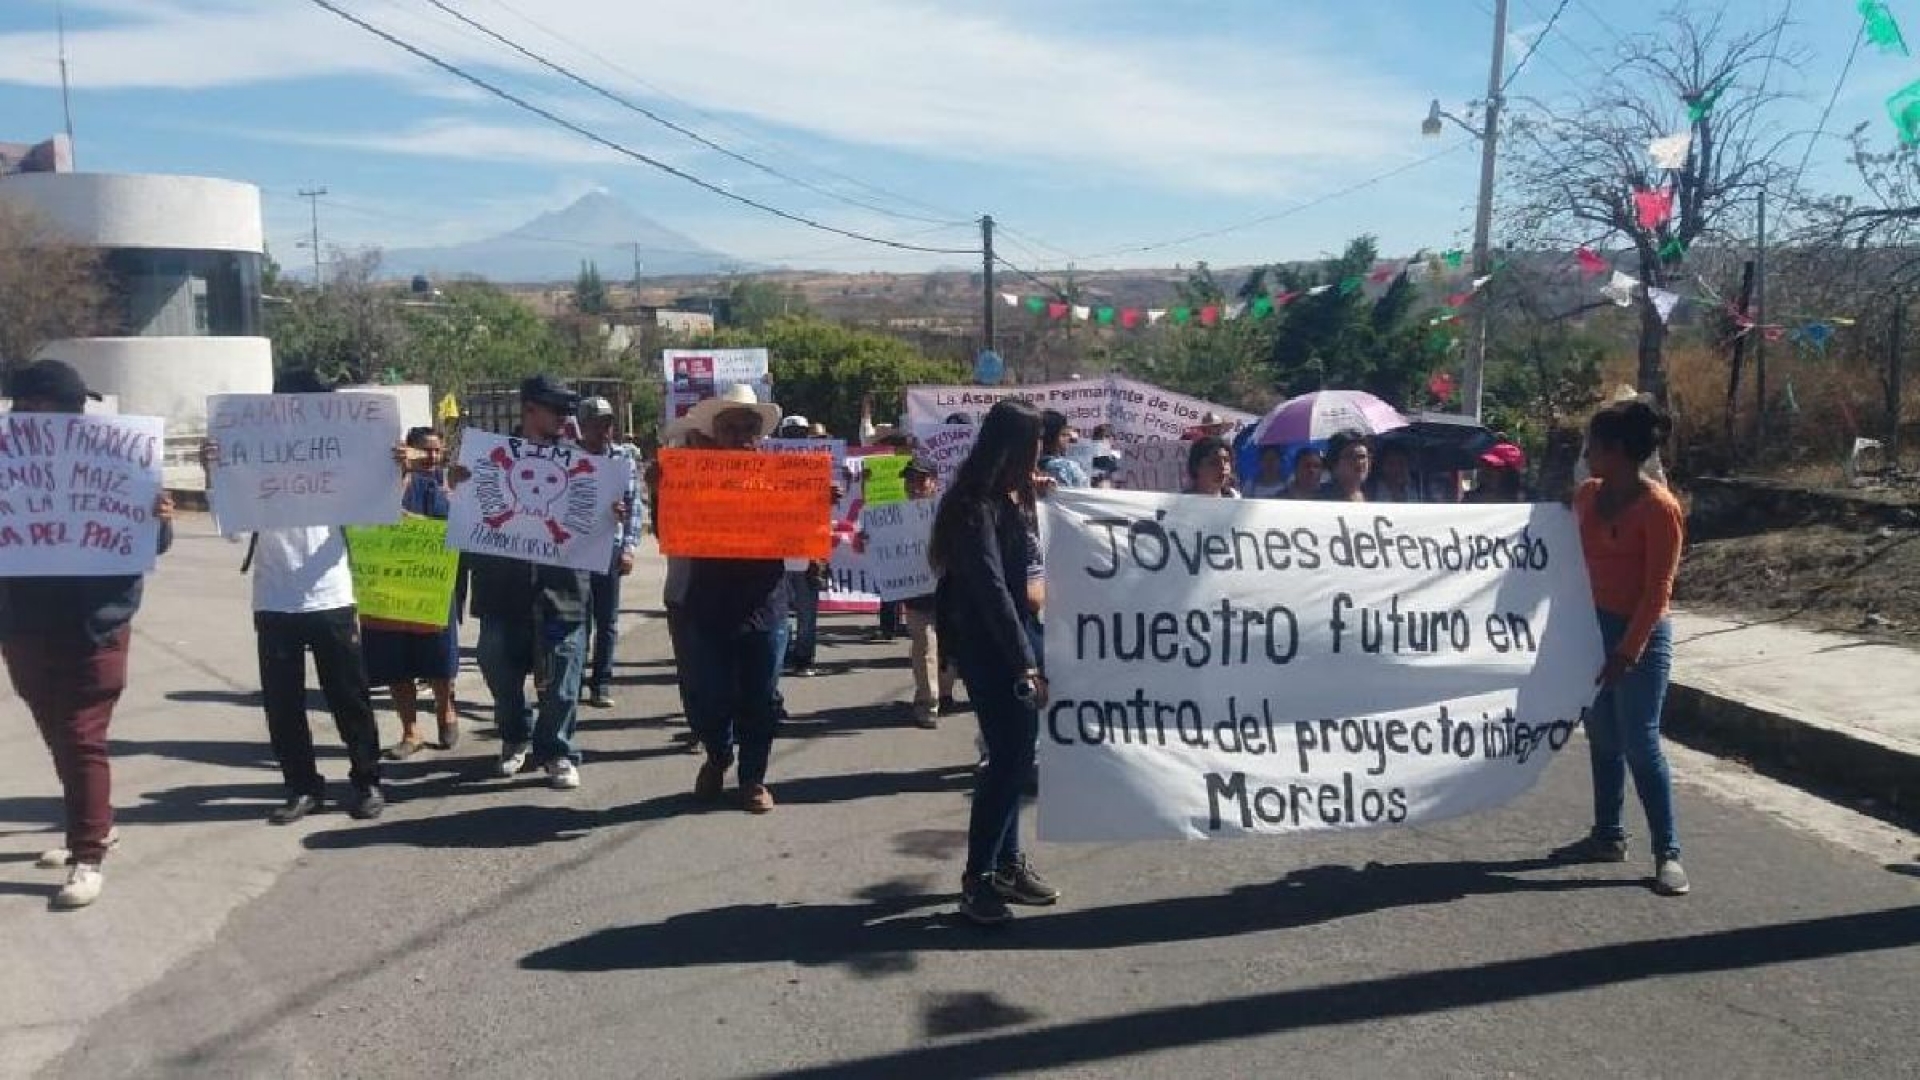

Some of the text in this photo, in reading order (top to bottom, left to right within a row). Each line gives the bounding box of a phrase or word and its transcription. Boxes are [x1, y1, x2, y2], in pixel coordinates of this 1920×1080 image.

[215, 397, 385, 429] SAMIR VIVE
[936, 391, 955, 406] La
[1050, 387, 1144, 404] Permanente
[1148, 397, 1169, 413] de
[1174, 402, 1199, 420] los
[261, 436, 342, 463] LUCHA
[256, 471, 338, 500] SIGUE
[27, 497, 53, 513] LA
[68, 493, 145, 523] TERMO
[29, 521, 72, 546] DEL
[1329, 515, 1549, 571] defendiendo
[1076, 592, 1537, 668] nuestro futuro en
[1048, 688, 1211, 749] contra
[1213, 696, 1277, 755] del
[1295, 705, 1476, 776] proyecto
[1203, 771, 1408, 831] Morelos
